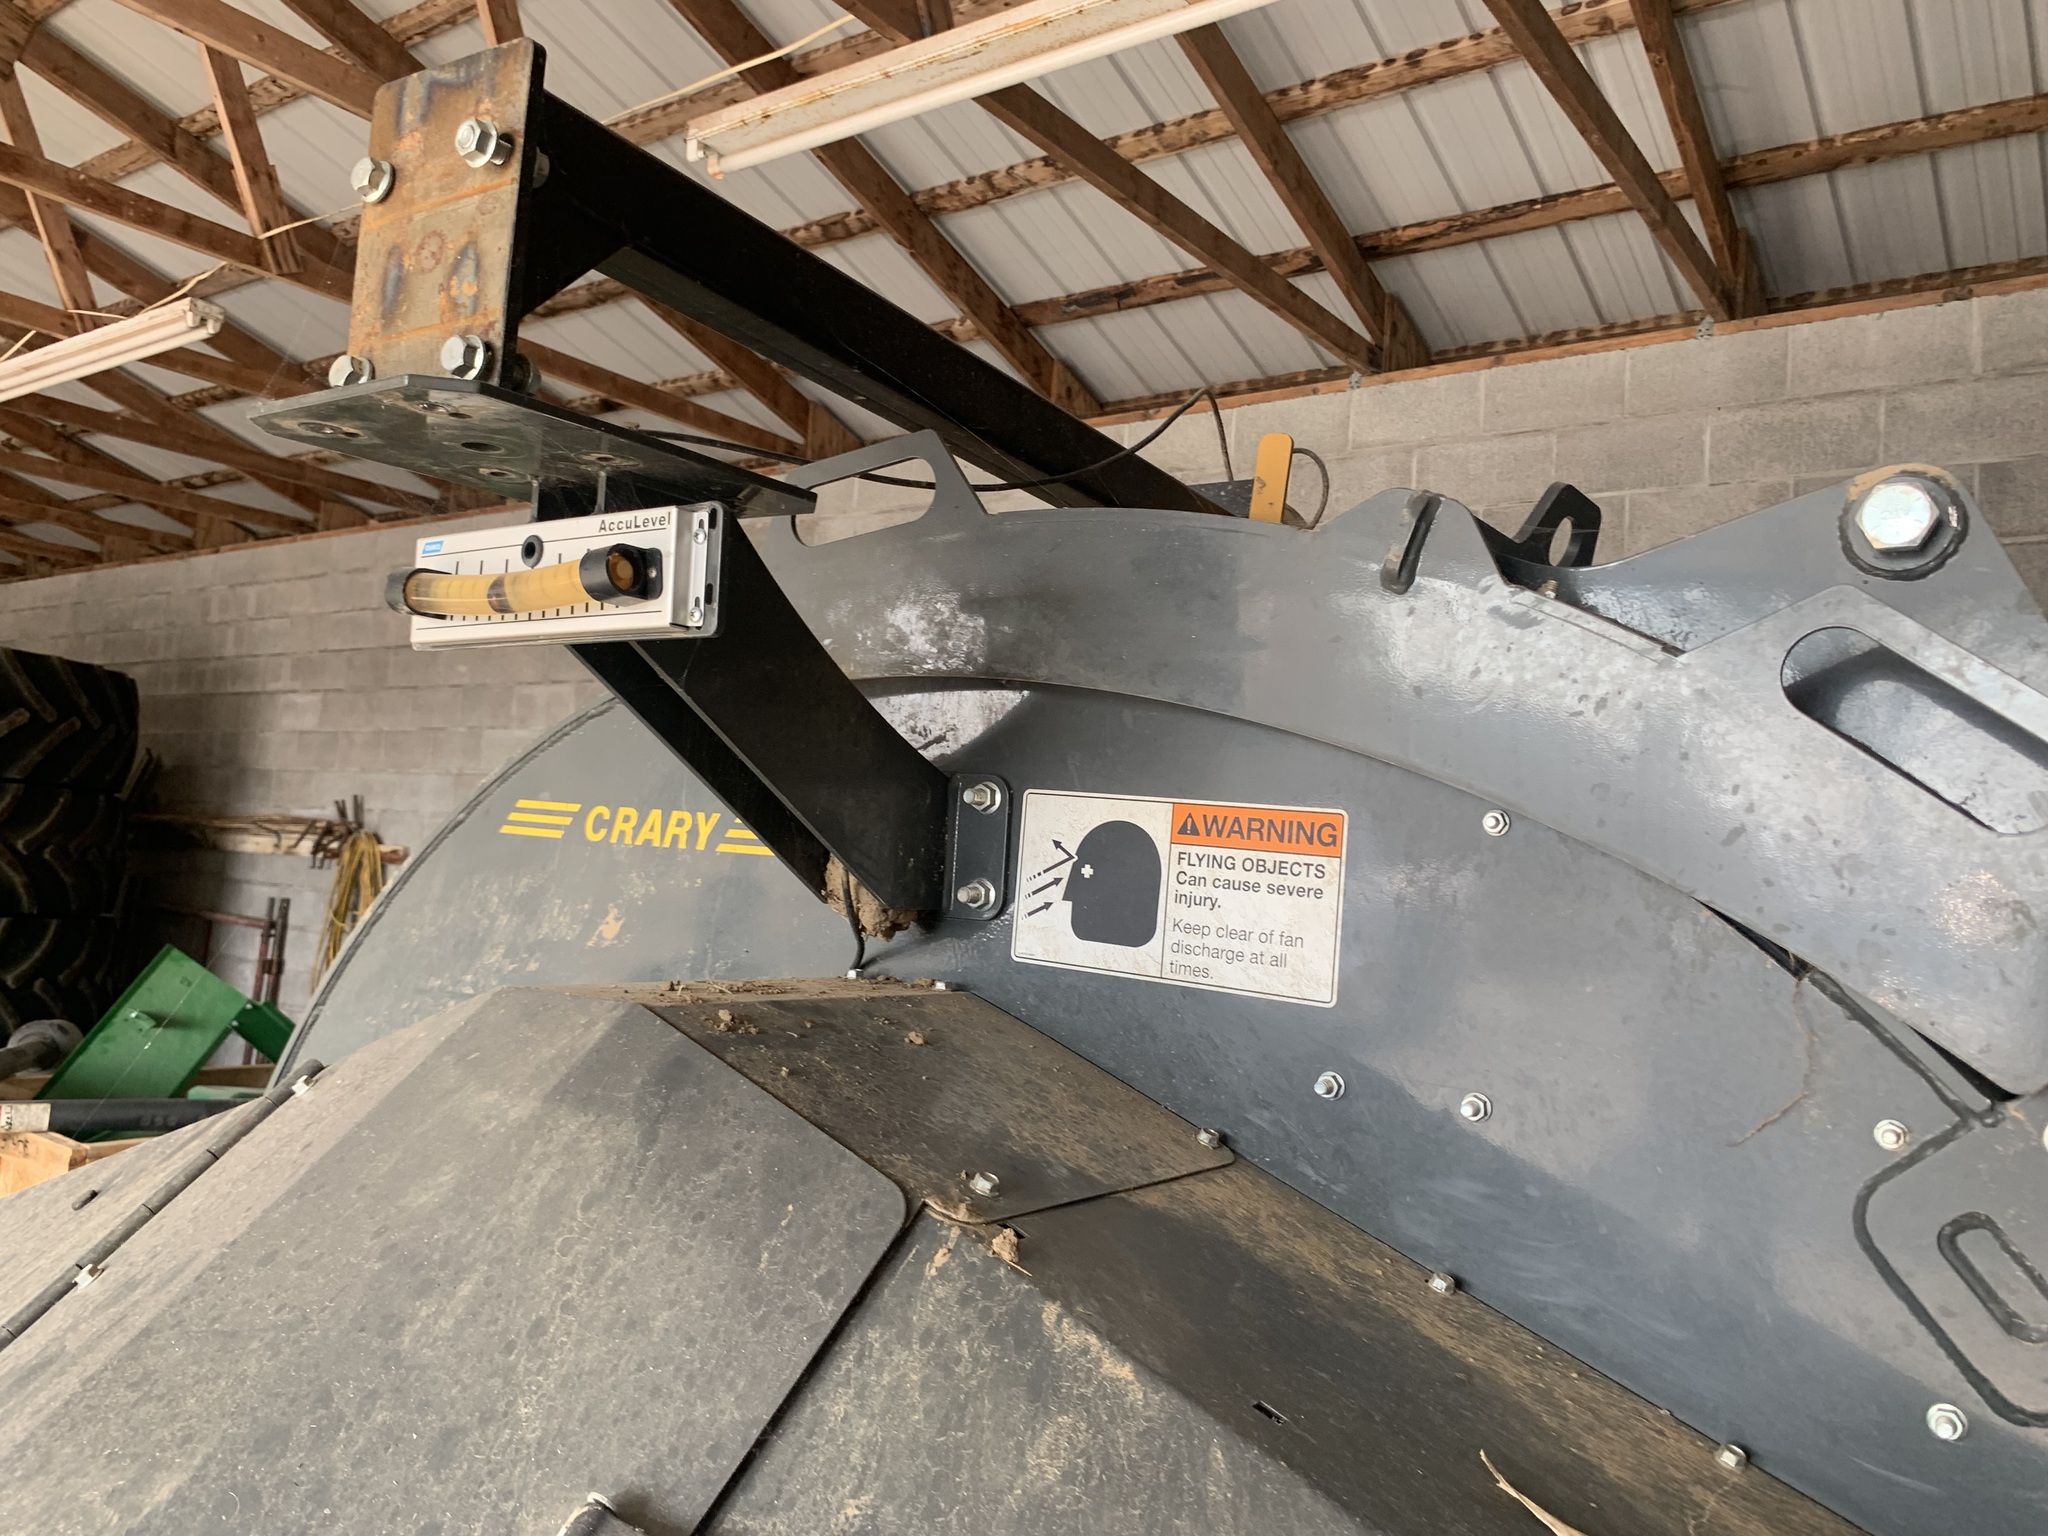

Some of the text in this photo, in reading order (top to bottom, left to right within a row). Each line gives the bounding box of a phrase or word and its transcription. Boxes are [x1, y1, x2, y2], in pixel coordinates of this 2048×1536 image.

[598, 511, 671, 533] AccuLevel
[584, 805, 721, 851] CRARY
[1202, 814, 1338, 847] WARNING
[1177, 851, 1326, 879] FLYING OBJECTS
[1176, 870, 1324, 900] Can cause severe
[1174, 889, 1221, 911] injury.
[1172, 917, 1304, 949] Keep clear of fan
[1170, 939, 1288, 968] discharge at all
[1169, 960, 1214, 979] times.
